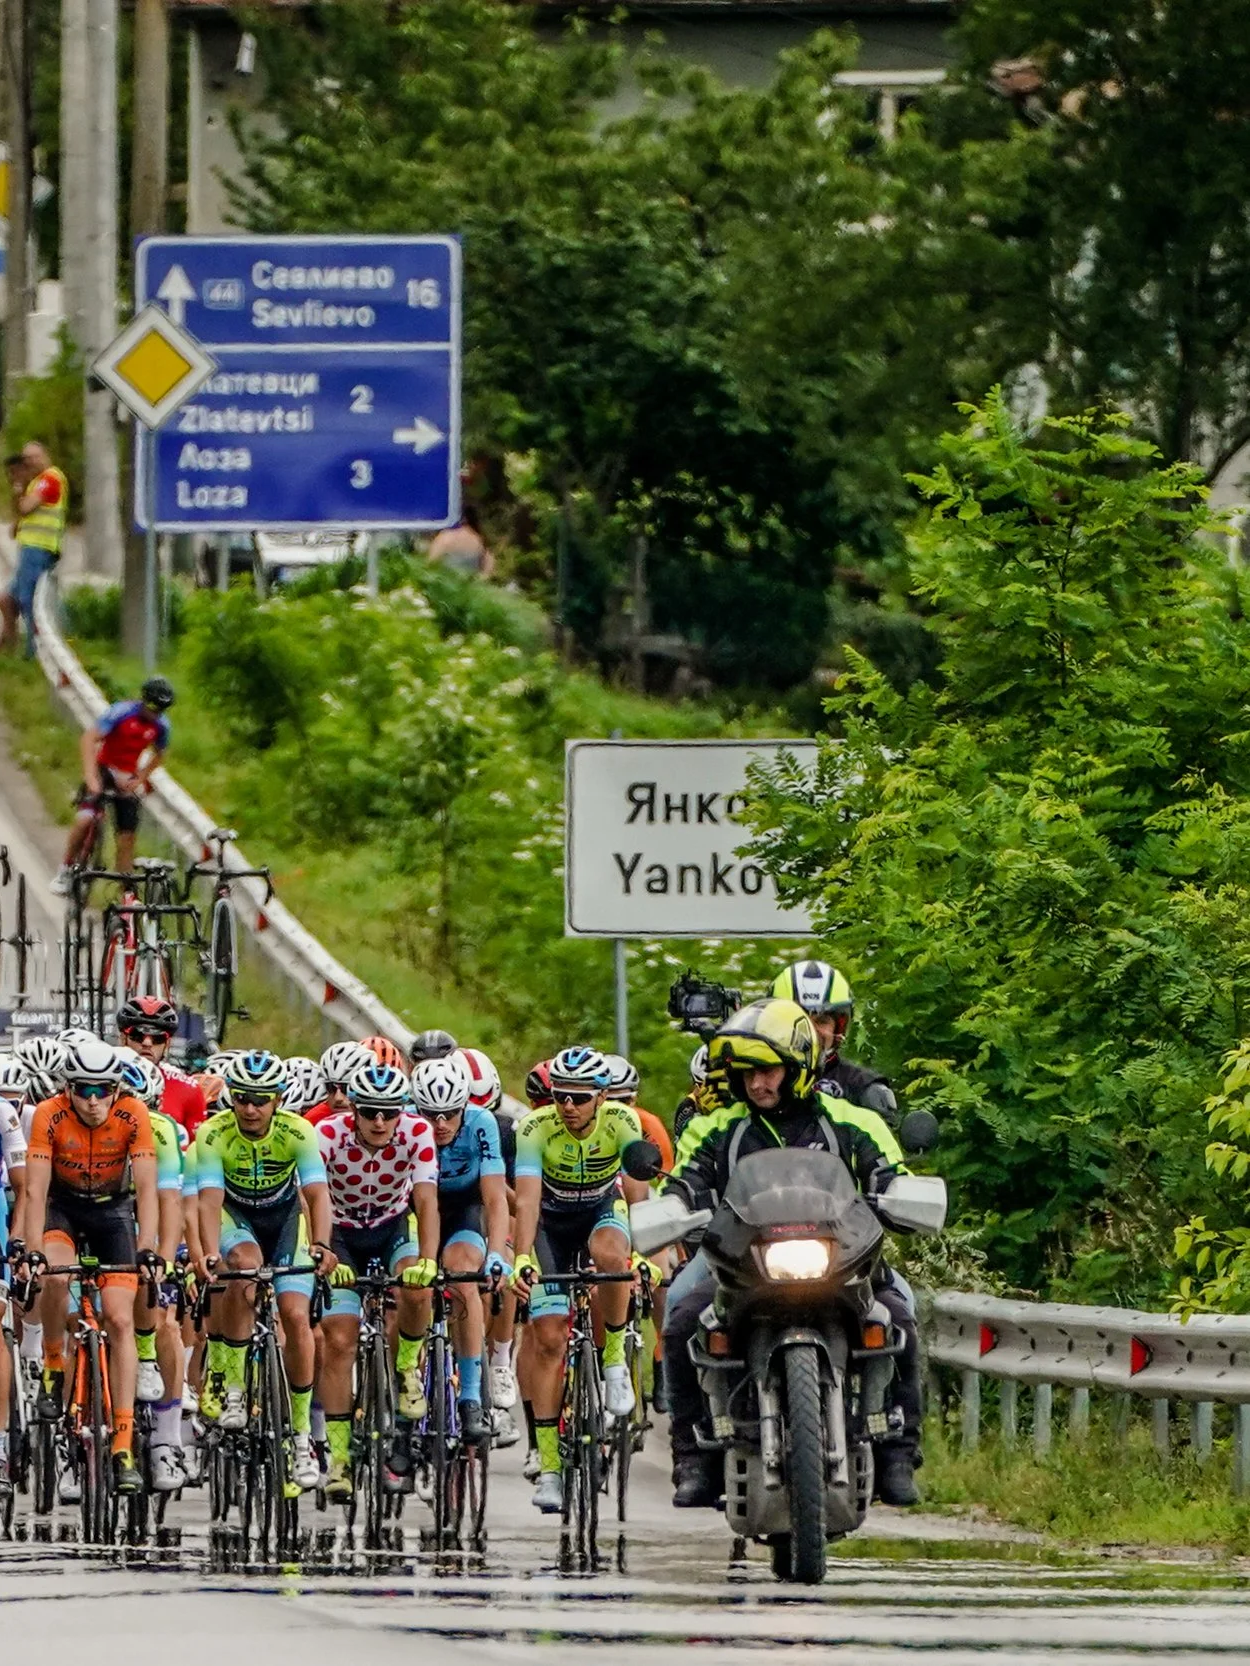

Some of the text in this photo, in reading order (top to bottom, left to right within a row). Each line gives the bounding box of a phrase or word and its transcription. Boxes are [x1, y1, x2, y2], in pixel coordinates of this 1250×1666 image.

[251, 260, 395, 290] Севлиево
[406, 279, 441, 309] 16
[251, 299, 376, 328] Sevlievo
[199, 371, 320, 398] латевци
[349, 385, 375, 414] 2
[177, 405, 314, 433] Zlatevtsi
[350, 460, 373, 489] 3
[176, 480, 248, 509] Loza
[624, 781, 750, 825] Янко
[612, 852, 781, 896] Yanko
